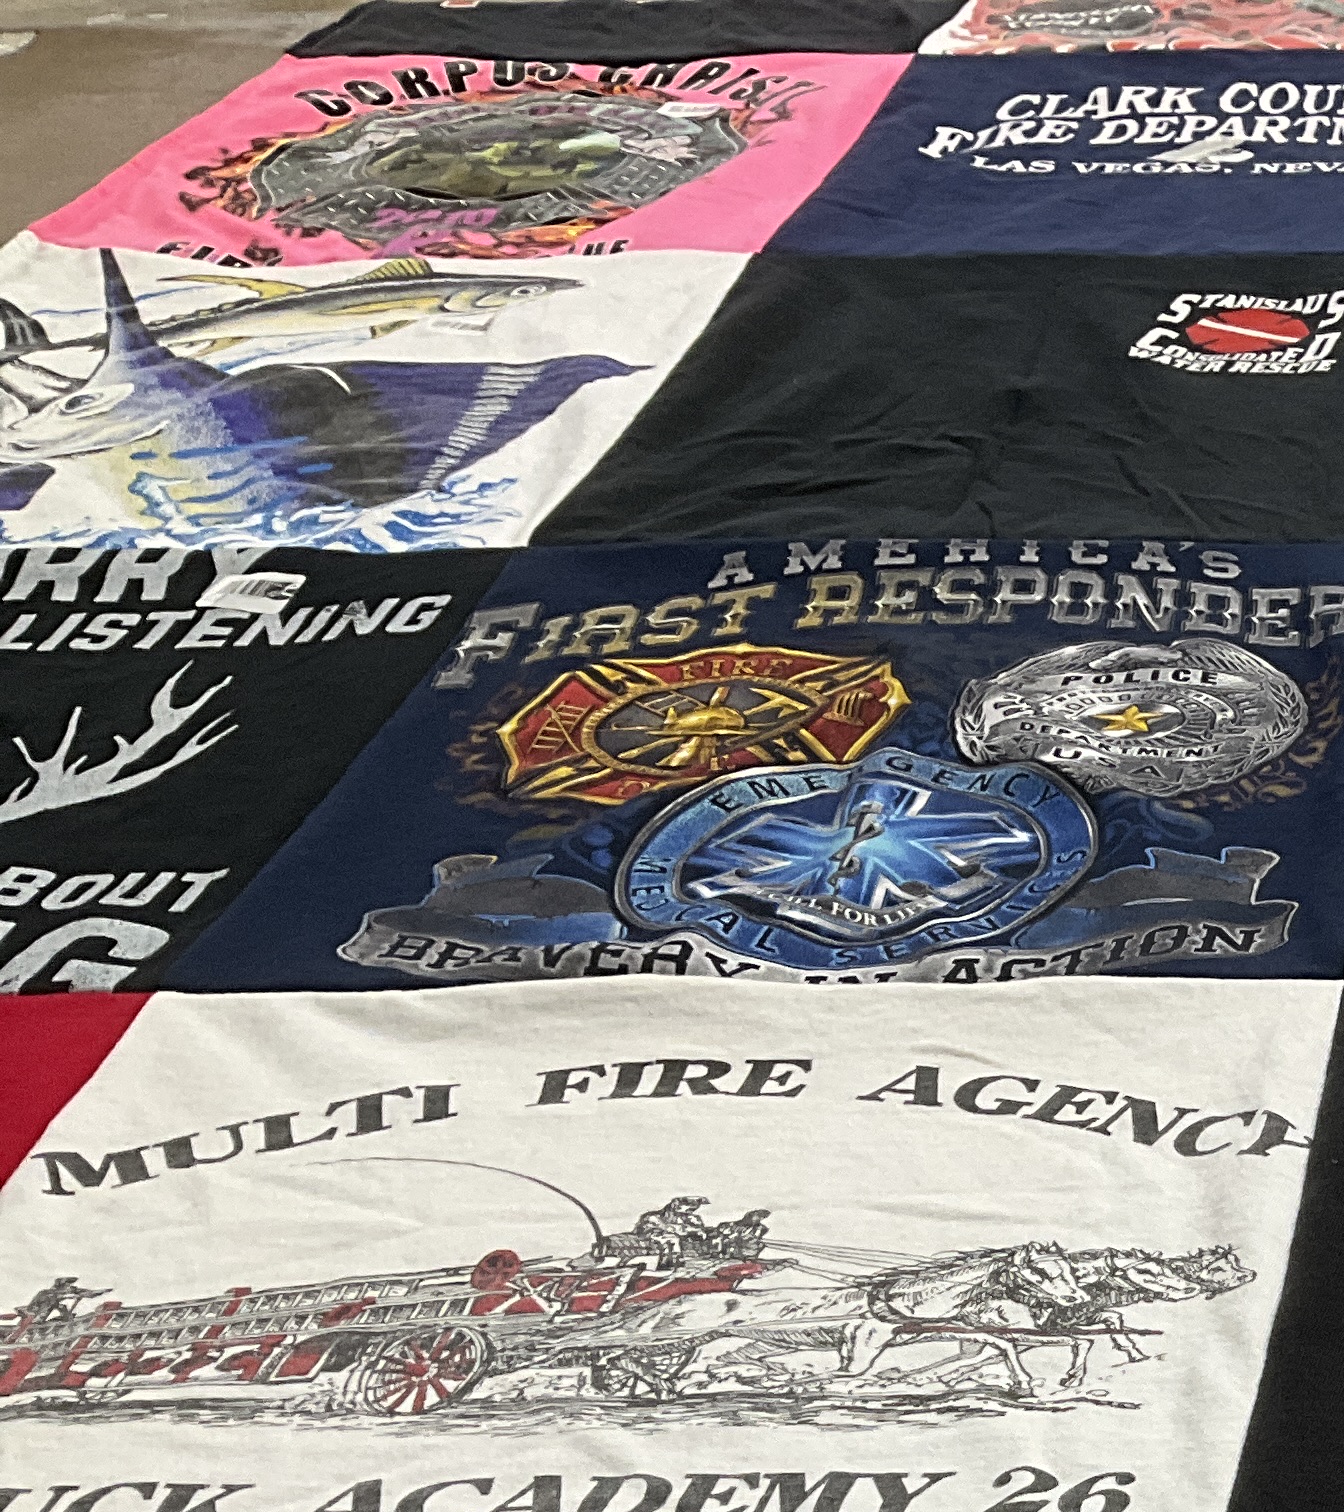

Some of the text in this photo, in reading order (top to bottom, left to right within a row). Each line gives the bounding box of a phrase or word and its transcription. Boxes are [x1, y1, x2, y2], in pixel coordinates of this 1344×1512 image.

[294, 60, 571, 117] CORPUS
[995, 84, 1204, 122] CLARK
[919, 119, 1080, 160] FIRE
[970, 155, 1056, 174] LAS
[1128, 345, 1337, 374] WATER RESCUE
[1134, 326, 1342, 364] CONSOLIDATED
[706, 537, 1241, 589] AMERICA'S
[0, 594, 453, 652] LISTENING
[430, 582, 778, 690] FIRST
[681, 657, 794, 681] FIRE
[1060, 668, 1219, 687] POLICE
[709, 754, 1061, 814] EMEGENCY
[831, 902, 879, 927] FOR
[377, 934, 761, 976] BRAVERY
[942, 922, 1264, 985] ACTION
[31, 1083, 462, 1196] MULTI
[525, 1057, 813, 1108] FIRE
